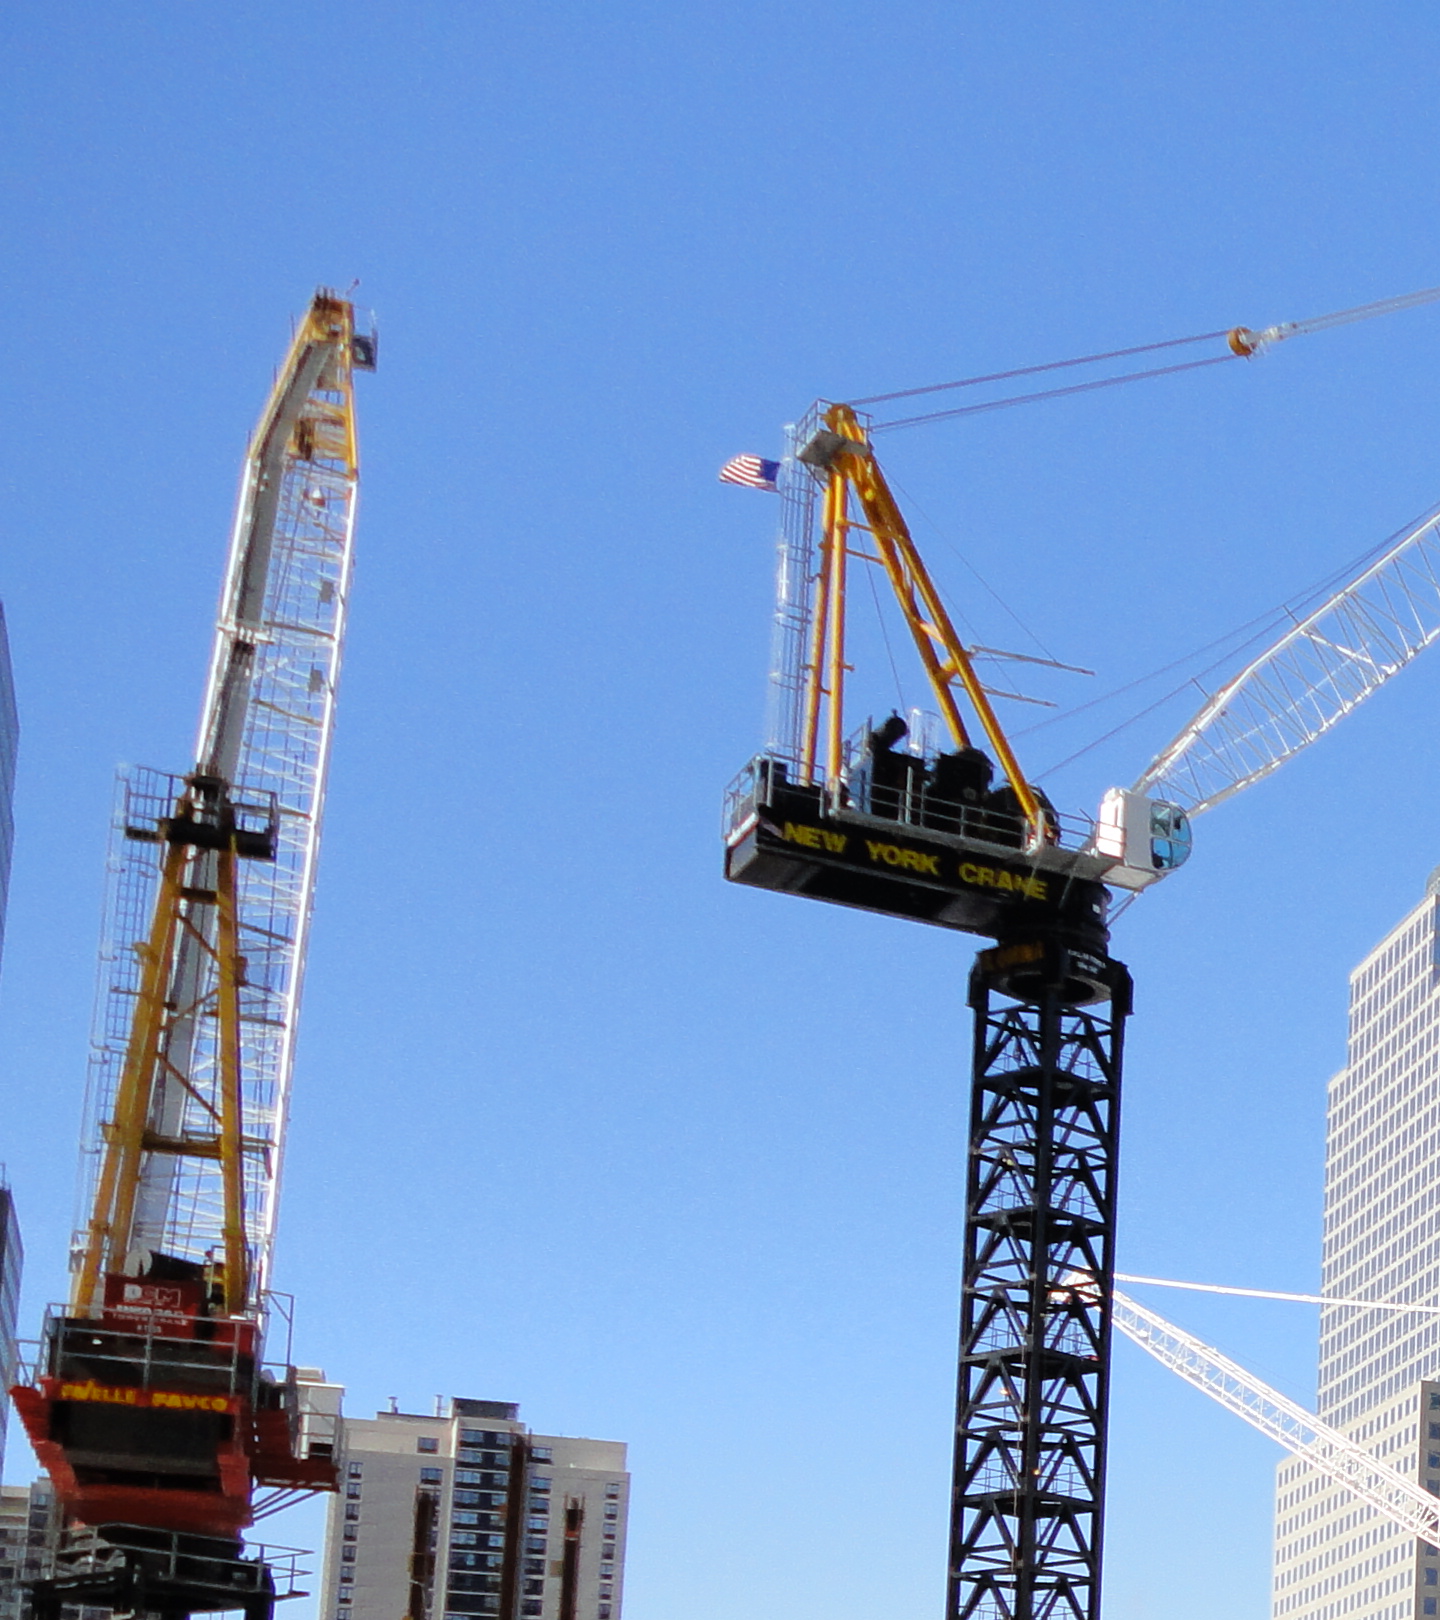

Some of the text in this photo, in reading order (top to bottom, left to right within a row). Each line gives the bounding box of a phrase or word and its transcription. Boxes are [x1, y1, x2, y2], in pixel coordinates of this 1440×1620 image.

[783, 821, 1048, 900] NEW YORK CRANE
